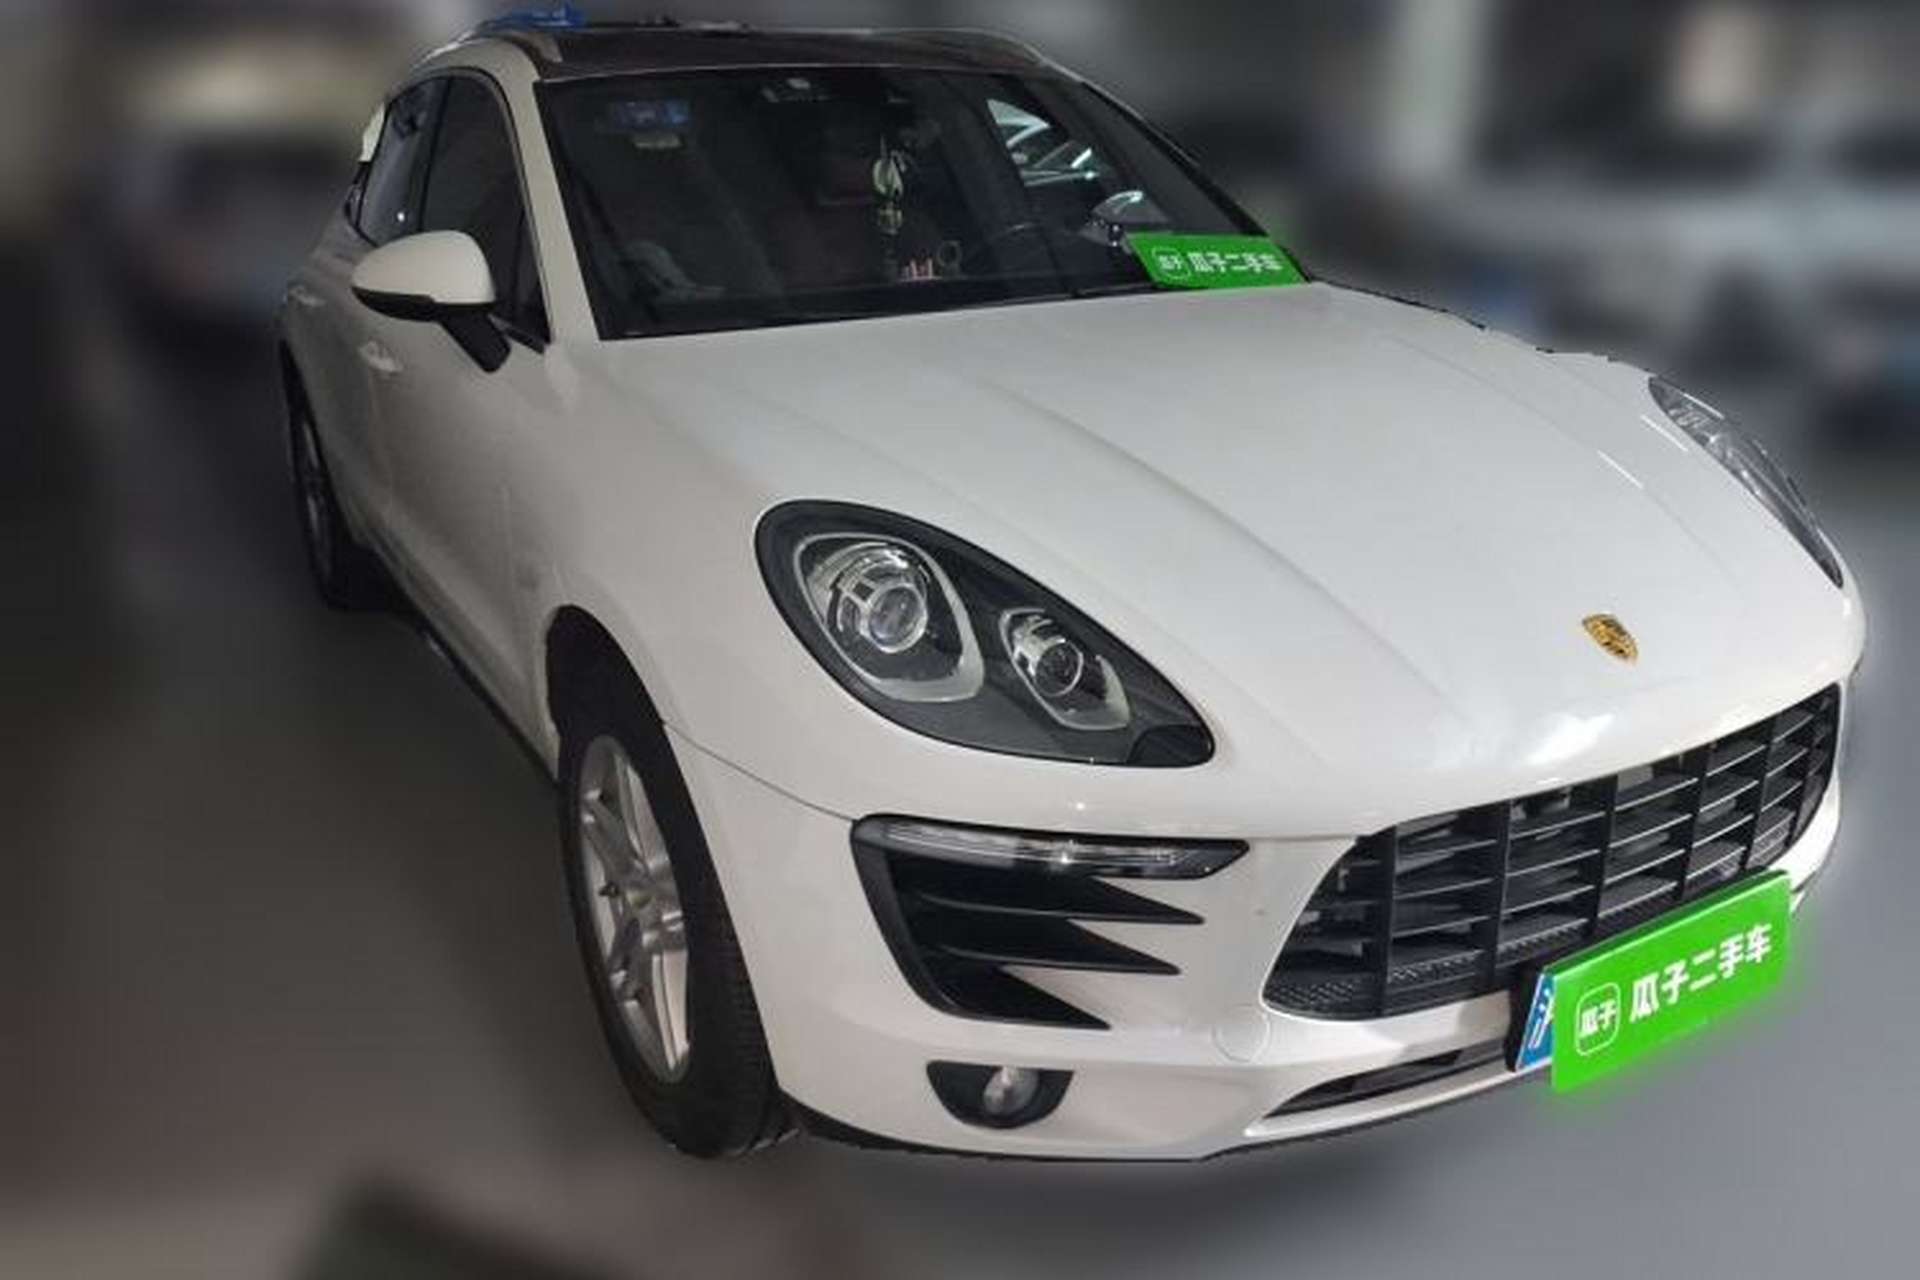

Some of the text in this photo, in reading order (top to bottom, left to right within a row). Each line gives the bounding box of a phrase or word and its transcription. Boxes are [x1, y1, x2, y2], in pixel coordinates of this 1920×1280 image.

[1187, 252, 1283, 273] 瓜子二手车
[1579, 998, 1616, 1037] 瓜子
[1630, 922, 1773, 1023] 瓜子二手车
